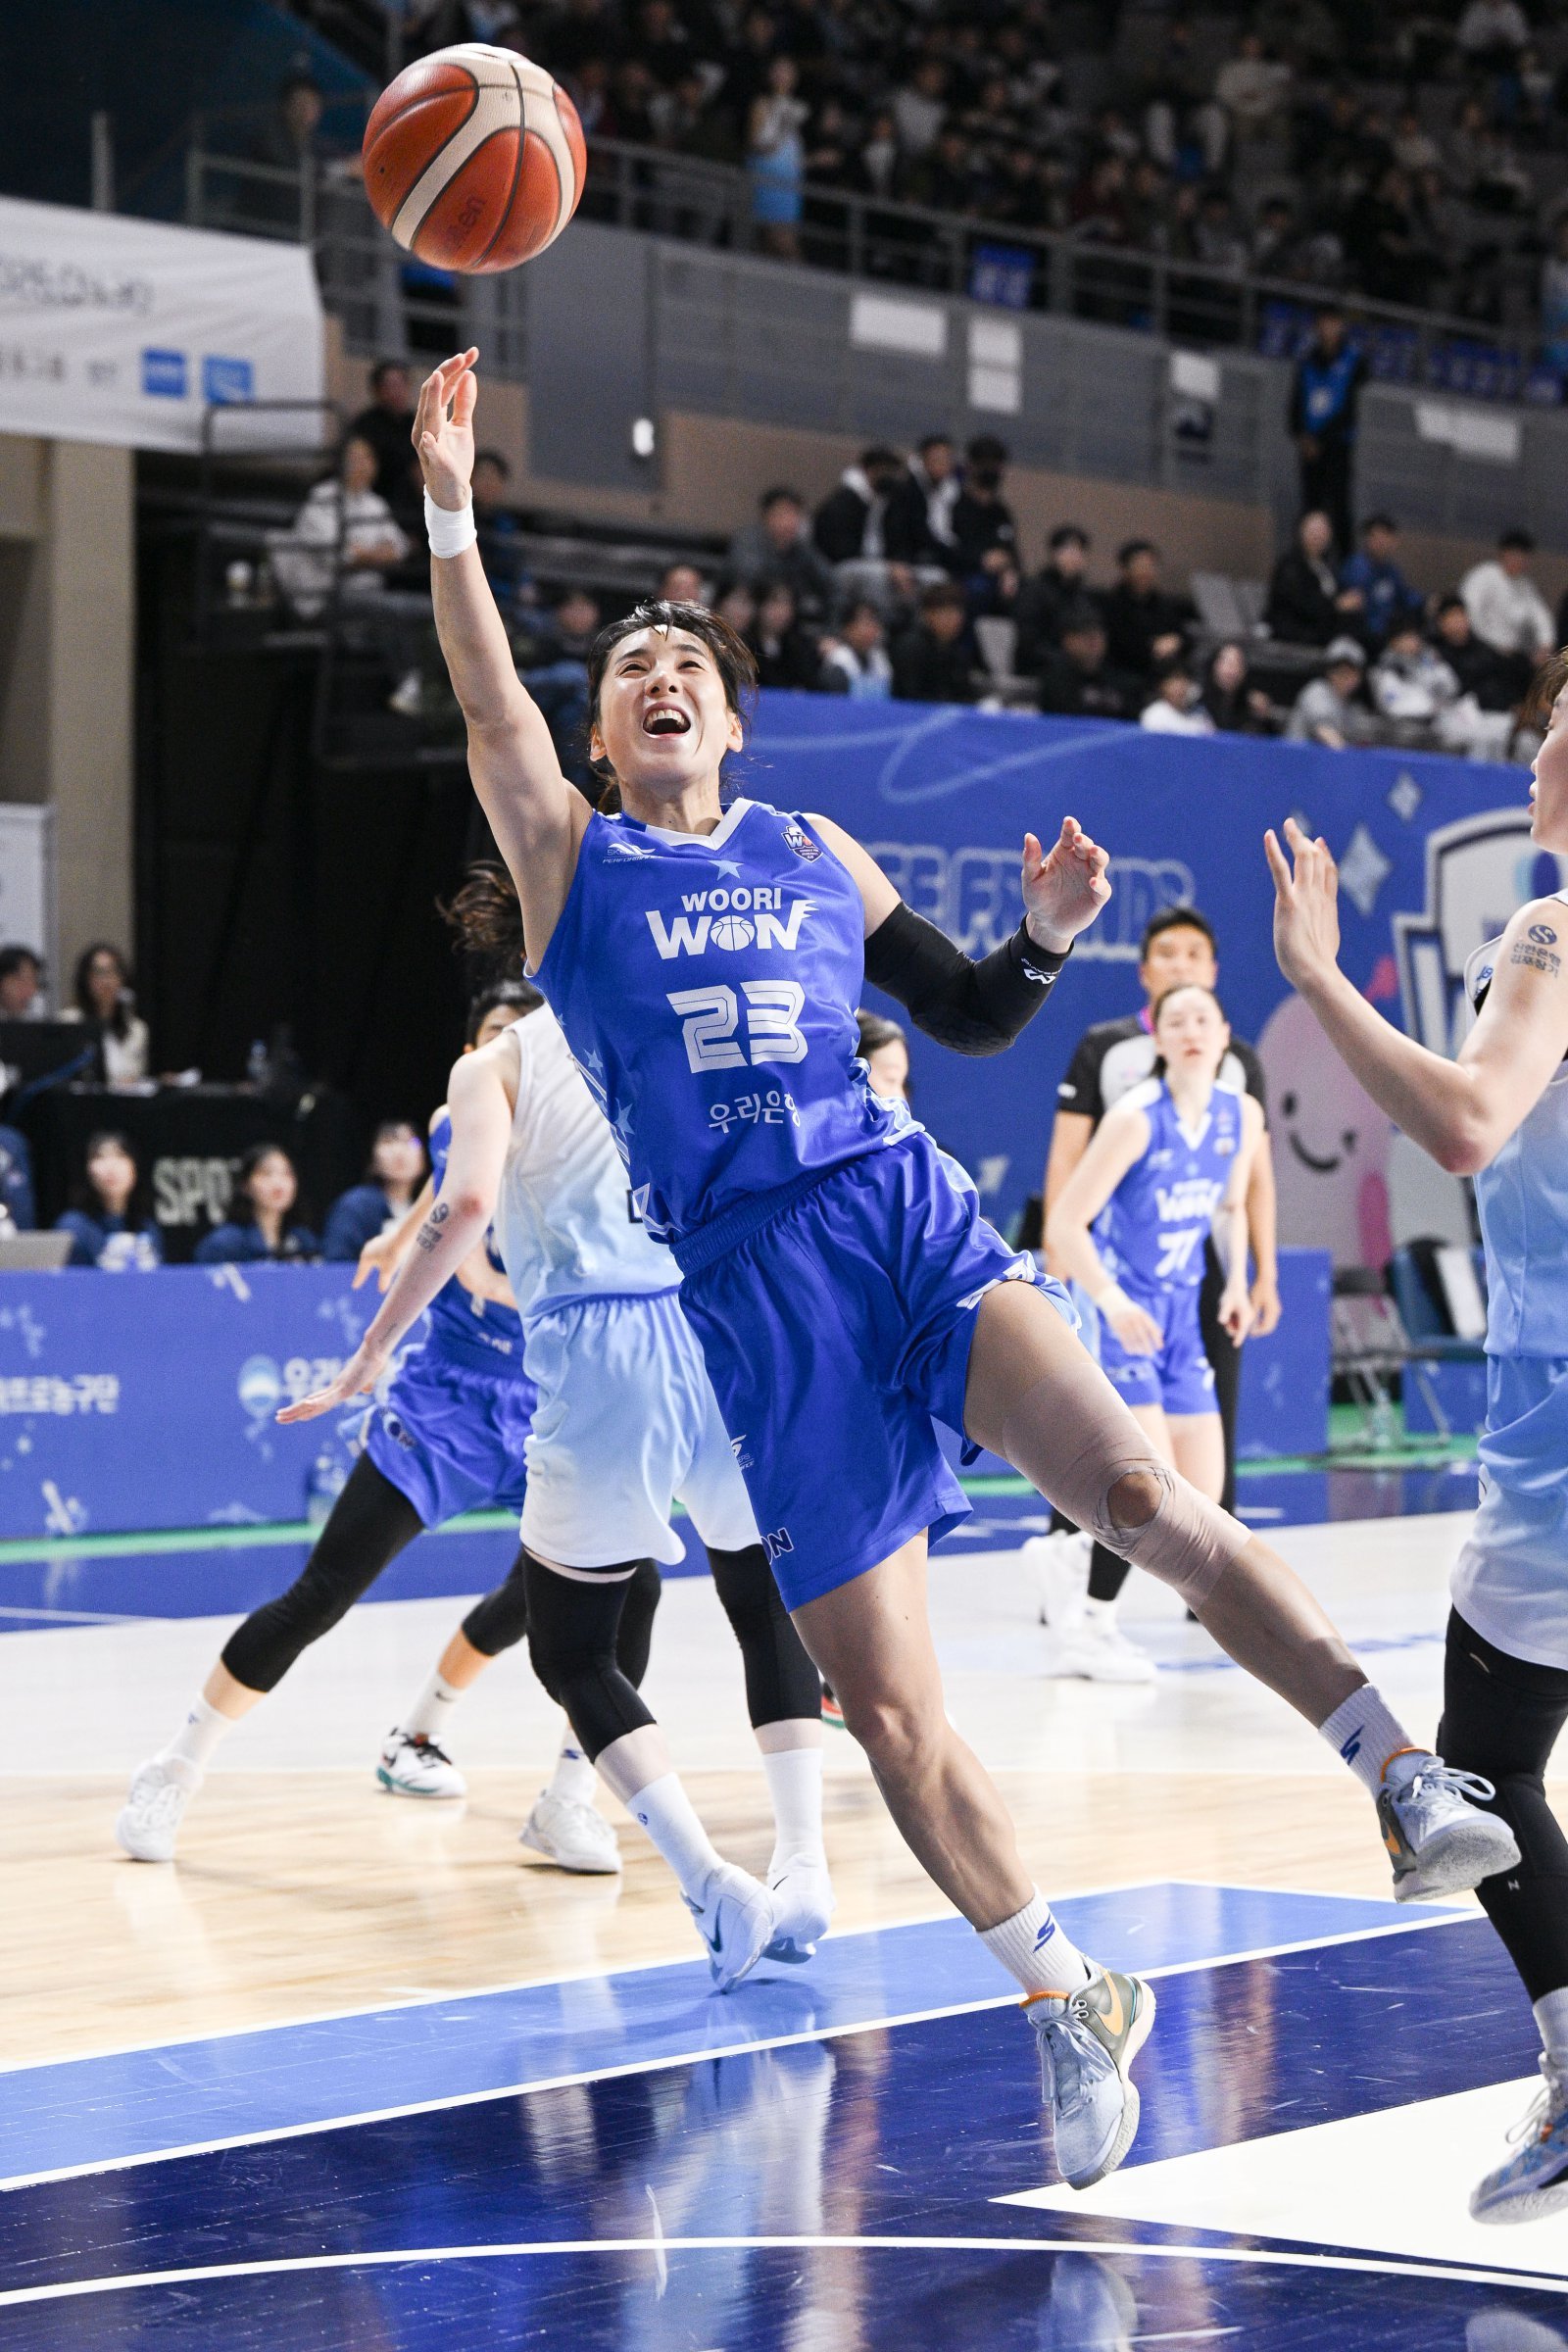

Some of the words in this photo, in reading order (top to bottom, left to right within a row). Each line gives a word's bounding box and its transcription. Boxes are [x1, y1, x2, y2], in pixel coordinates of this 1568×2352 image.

[681, 888, 782, 912] WOORI
[645, 900, 820, 960] WON
[665, 980, 808, 1074] 23
[0, 1374, 119, 1416] 프로농구단
